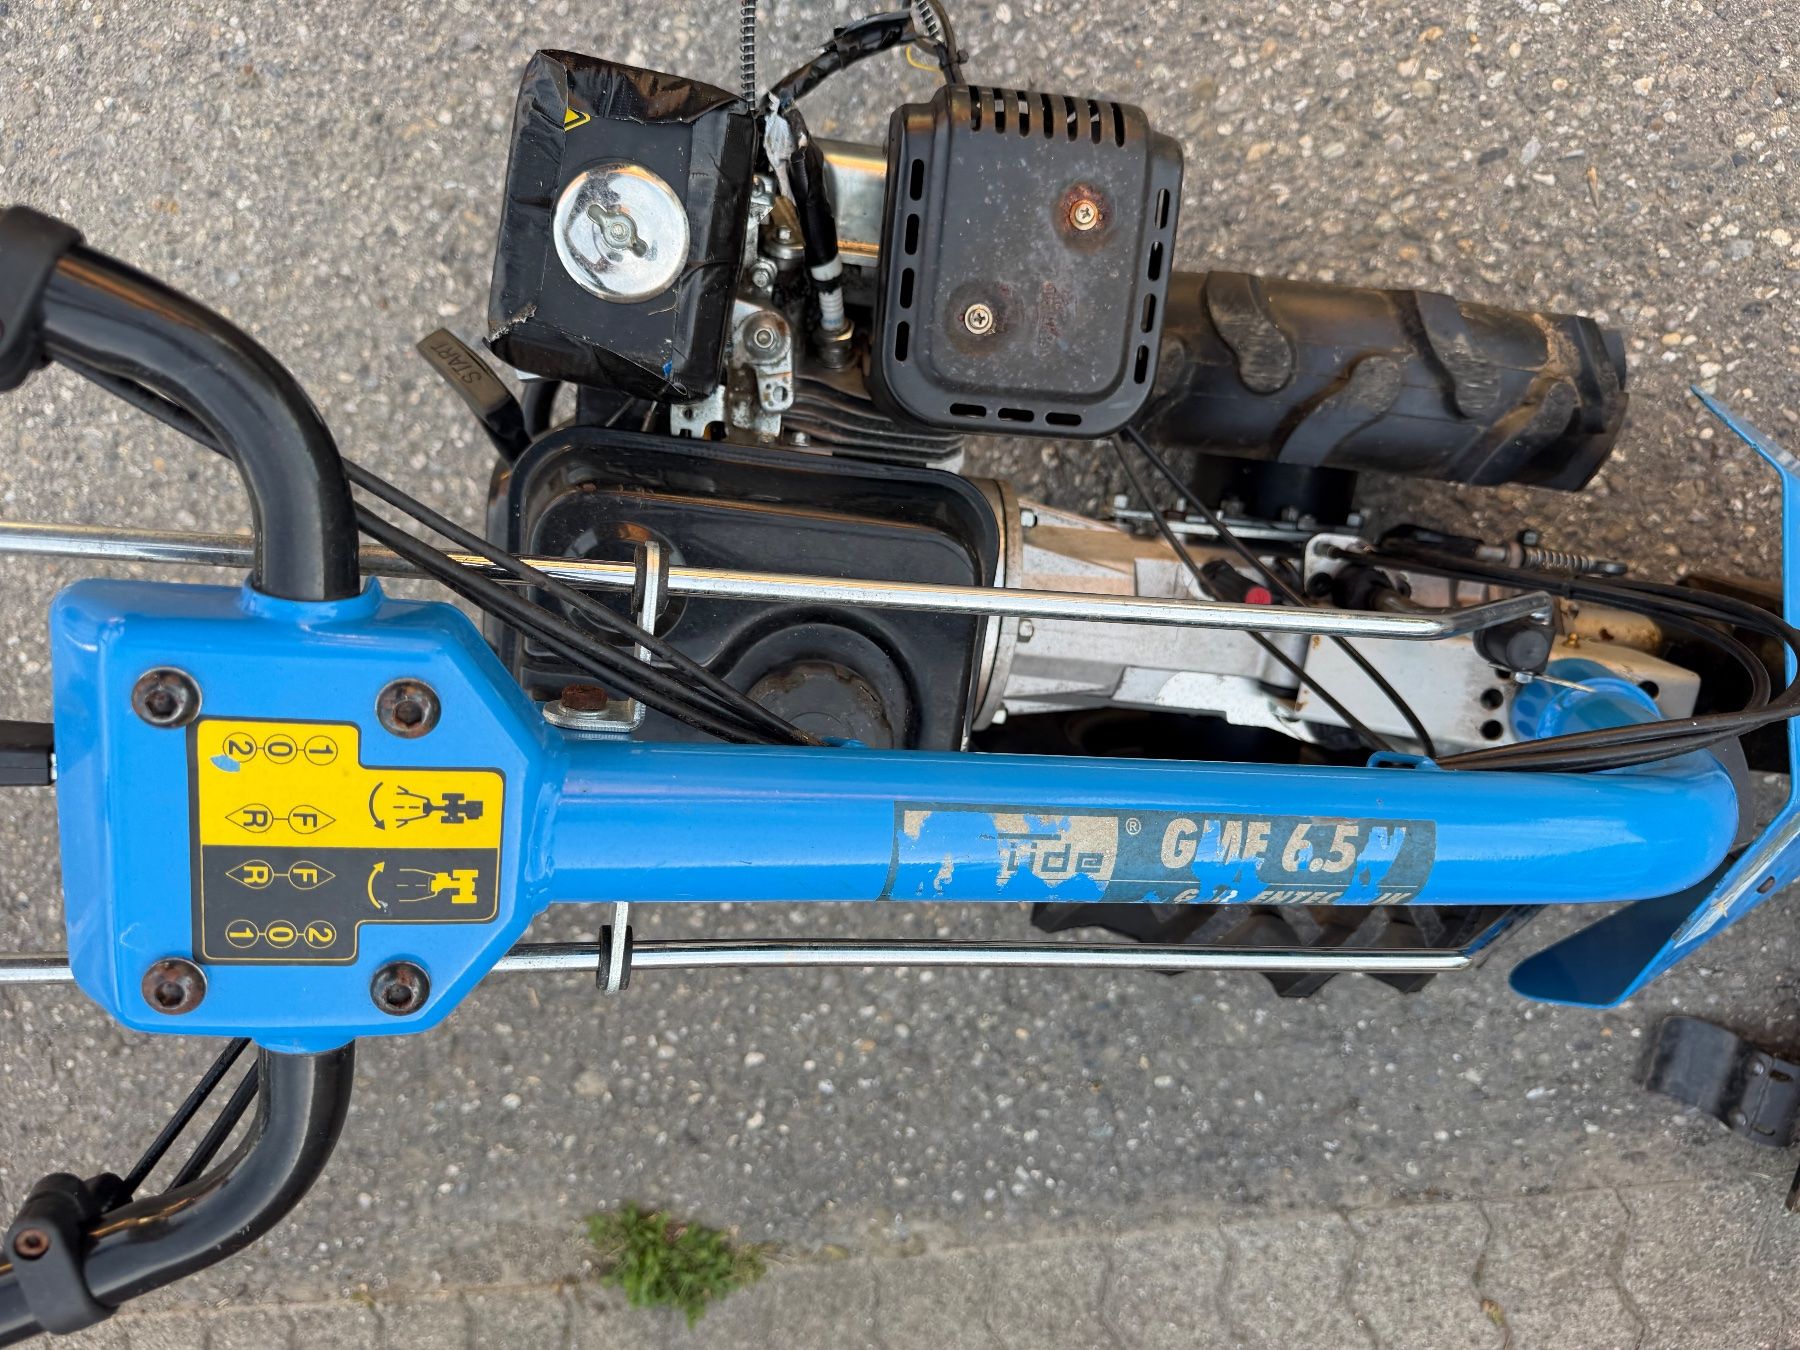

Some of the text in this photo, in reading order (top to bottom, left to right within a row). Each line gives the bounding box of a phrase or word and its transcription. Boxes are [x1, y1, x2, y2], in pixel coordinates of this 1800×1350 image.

[430, 344, 481, 384] START
[228, 739, 255, 756] 2
[308, 744, 334, 756] 1
[243, 810, 268, 827] R
[292, 813, 318, 828] F
[1281, 823, 1359, 873] 6.5
[243, 866, 269, 882] R
[292, 868, 318, 884] F
[229, 927, 255, 939] 1
[308, 926, 333, 942] 2
